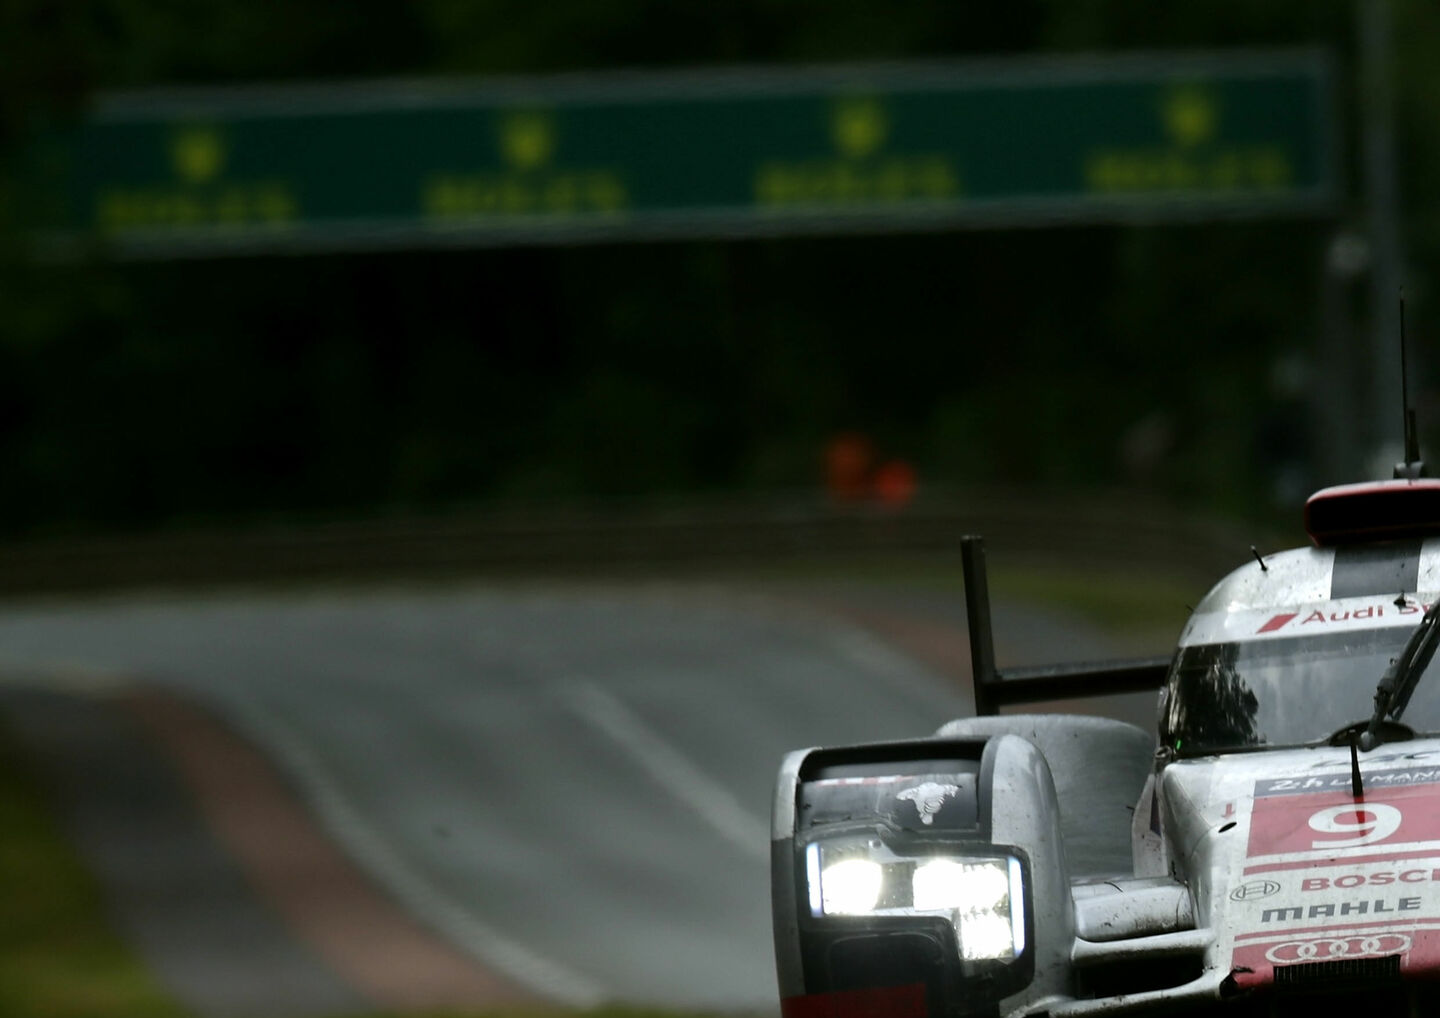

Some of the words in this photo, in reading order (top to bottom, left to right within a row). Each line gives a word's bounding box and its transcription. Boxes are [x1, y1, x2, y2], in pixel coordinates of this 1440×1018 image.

[1302, 605, 1384, 625] Audi
[1308, 803, 1402, 849] 9
[1261, 896, 1421, 923] MAHLE
